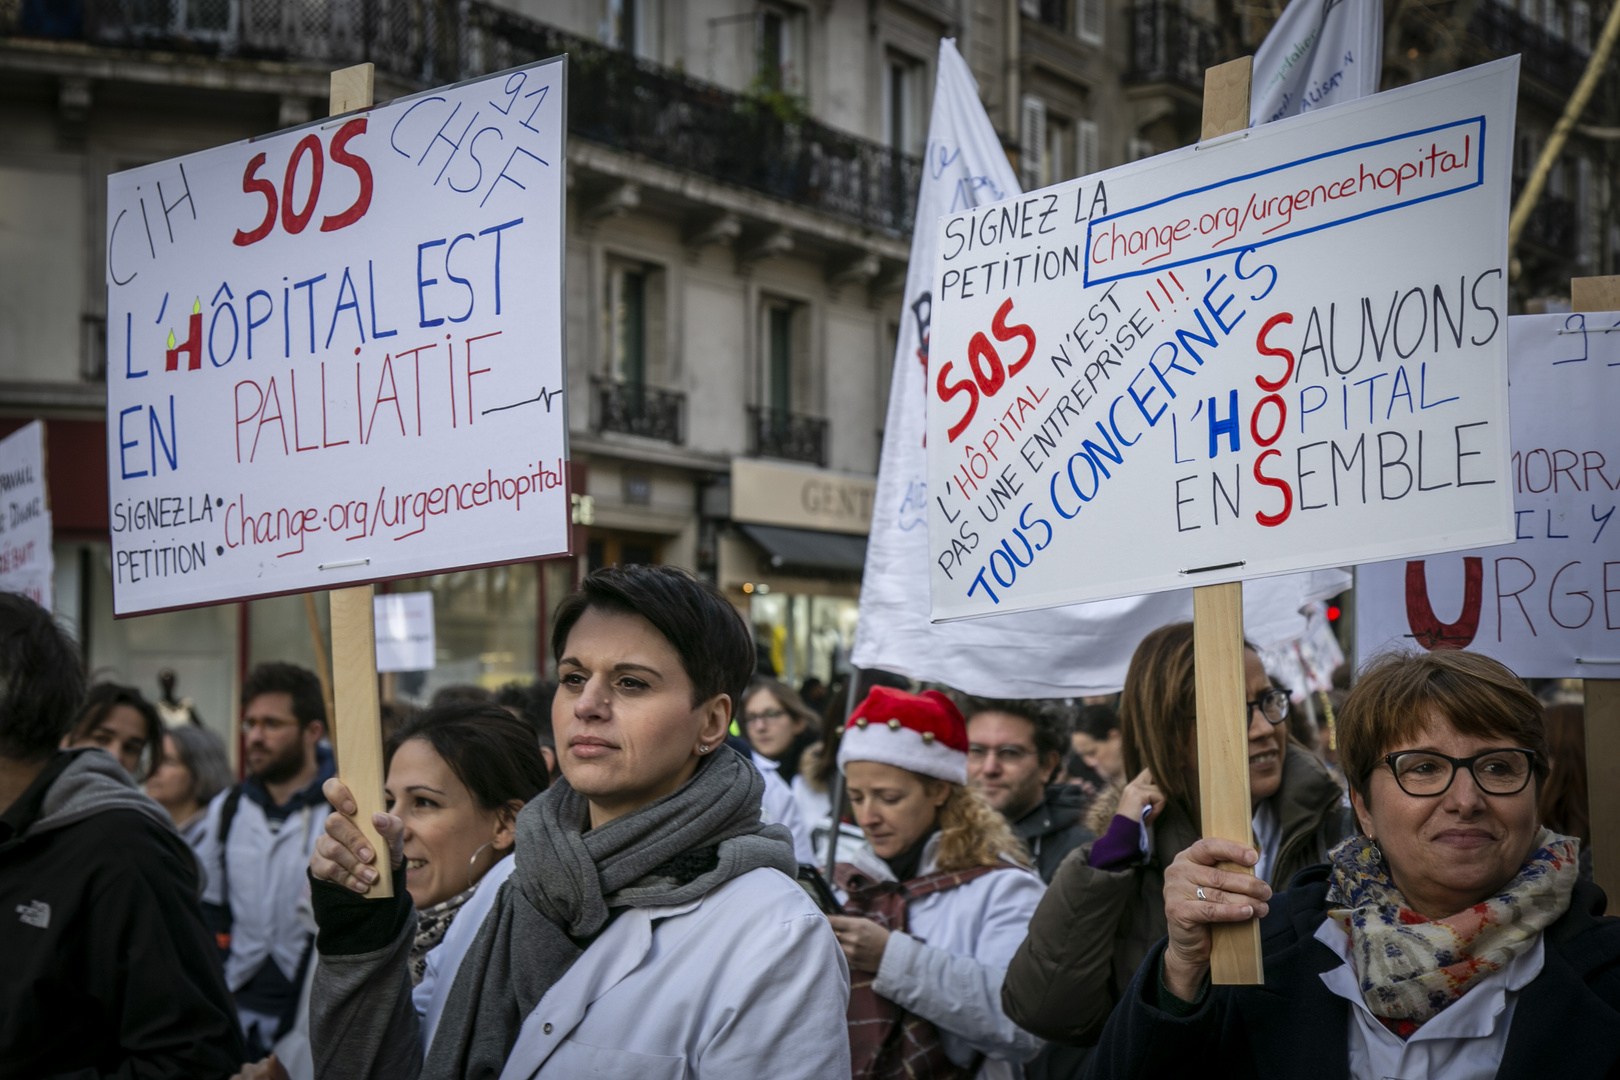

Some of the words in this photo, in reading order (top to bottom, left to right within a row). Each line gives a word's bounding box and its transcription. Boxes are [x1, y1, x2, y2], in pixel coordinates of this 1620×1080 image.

[391, 97, 549, 208] CHSF
[489, 72, 549, 134] 91
[232, 118, 374, 247] SOS
[943, 194, 1058, 261] SIGNEZ
[1075, 180, 1108, 225] LA
[417, 218, 524, 328] EST
[942, 245, 1080, 301] PETITION
[936, 297, 1036, 443] SOS
[1051, 281, 1121, 378] N'EST
[1255, 268, 1502, 392] SAUVONS
[120, 395, 178, 480] EN
[235, 331, 502, 463] PALLIATIF
[967, 502, 1053, 605] TOUS
[1050, 247, 1277, 519] CONCERNÉS
[112, 496, 186, 532] SIGNEZ
[189, 493, 213, 524] LA
[938, 520, 979, 580] PAS
[978, 464, 1024, 522] UNE
[1176, 421, 1496, 532] ENSEMBLE
[116, 537, 206, 584] PETITION
